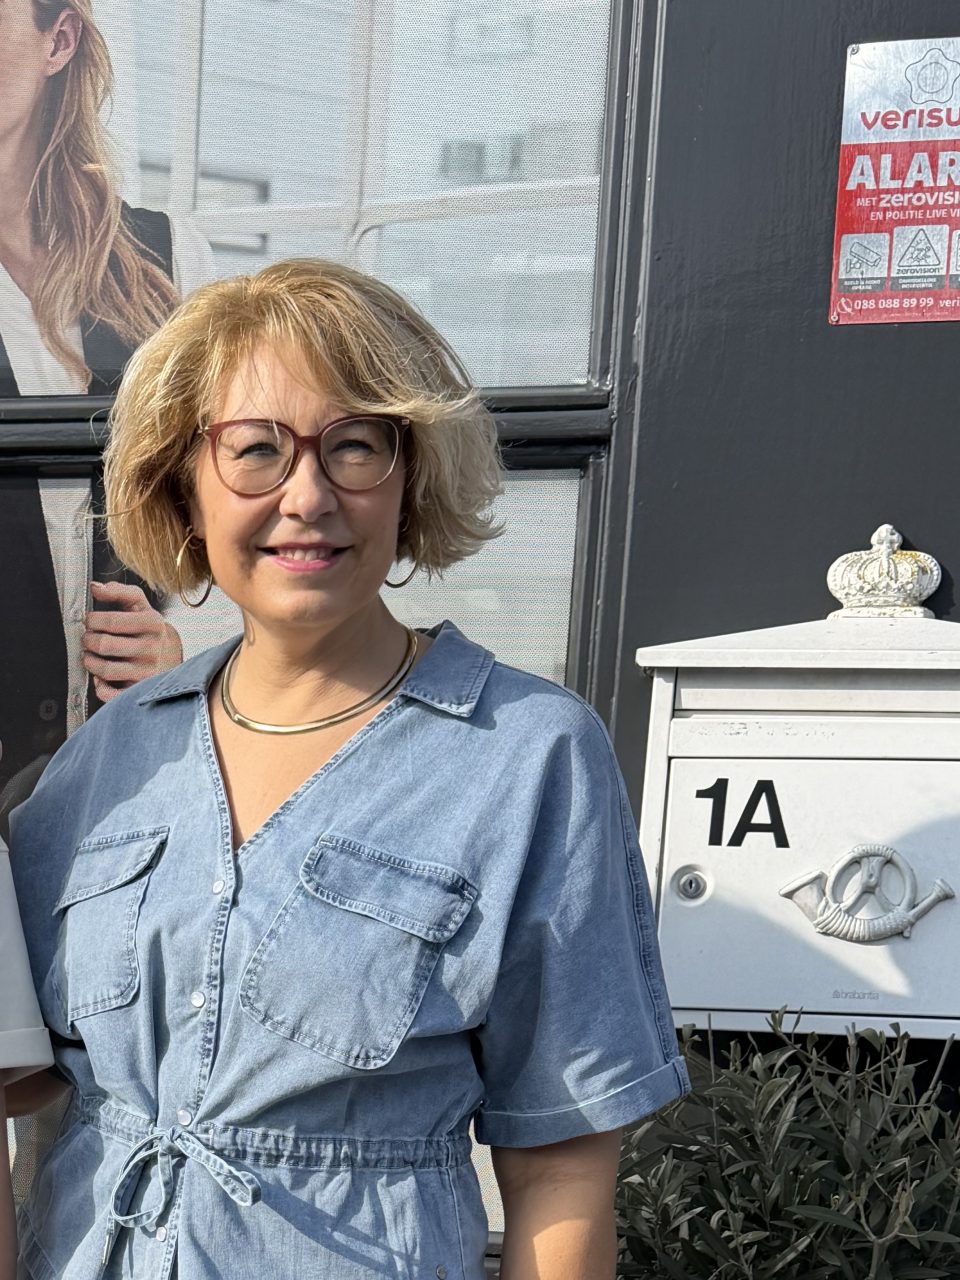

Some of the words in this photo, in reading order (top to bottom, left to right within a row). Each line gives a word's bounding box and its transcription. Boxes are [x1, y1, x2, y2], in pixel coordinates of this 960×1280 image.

[856, 197, 877, 207] MET
[870, 211, 883, 220] EN
[885, 209, 924, 220] POLITIE
[926, 208, 948, 219] LIVE
[854, 299, 876, 309] 088
[878, 298, 900, 309] 088
[902, 298, 917, 308] 89
[920, 297, 934, 307] 99
[695, 777, 790, 849] 1A
